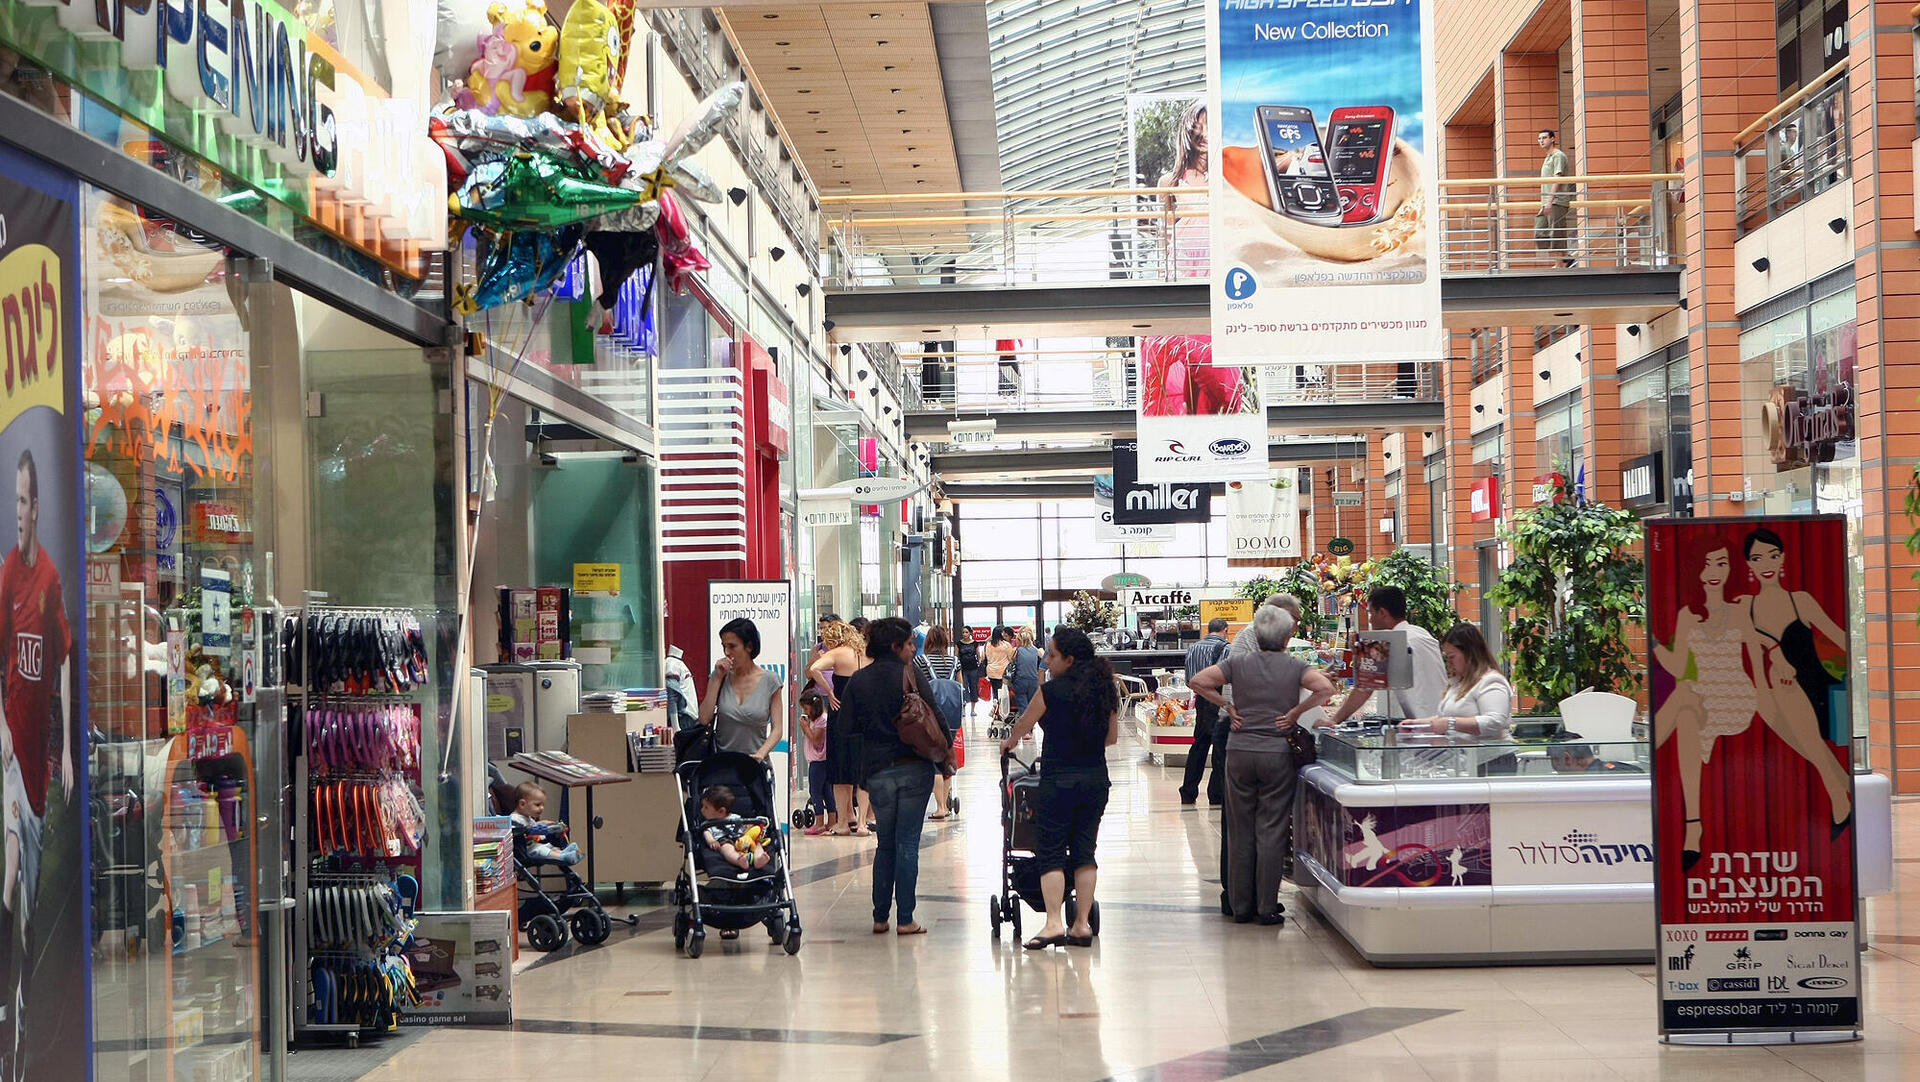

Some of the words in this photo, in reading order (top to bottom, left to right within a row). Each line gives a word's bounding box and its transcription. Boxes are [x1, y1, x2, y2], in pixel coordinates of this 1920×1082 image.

[1255, 23, 1296, 41] New
[1301, 20, 1389, 40] Collection
[1280, 129, 1301, 140] GPS
[1294, 269, 1335, 283] בפלאפון
[1338, 272, 1374, 281] החדשה
[1376, 269, 1423, 281] הקולקציה
[1226, 301, 1254, 311] פלאפון
[1225, 323, 1276, 335] סופר-לינק
[1279, 323, 1309, 332] ברשת
[1311, 322, 1358, 331] מתקדמים
[1360, 321, 1403, 330] מכשירים
[1404, 319, 1428, 330] מגוון
[1126, 483, 1199, 510] miller
[809, 513, 827, 525] חרום
[828, 511, 850, 525] יציאת
[1129, 526, 1153, 535] קומה
[1236, 535, 1292, 550] DOMO
[712, 593, 745, 604] הכוכבים
[746, 593, 770, 604] שבעת
[771, 592, 787, 606] קניון
[757, 607, 780, 620] מאחל
[19, 638, 41, 676] AIG
[1709, 851, 1798, 875] שדרת
[1687, 875, 1824, 900] המעצבים
[1687, 900, 1750, 915] להתלבש
[1754, 901, 1782, 912] שלי
[1786, 901, 1825, 915] הדרך
[1666, 929, 1698, 942] XOXO
[1726, 962, 1763, 970] GRIP
[1723, 979, 1758, 989] cassidi
[1677, 1002, 1763, 1019] espressobar
[1766, 1003, 1787, 1014] ליד
[1791, 1003, 1803, 1014] ב'
[1807, 1003, 1840, 1017] קומה
[428, 1016, 452, 1025] game
[453, 1015, 467, 1023] set
